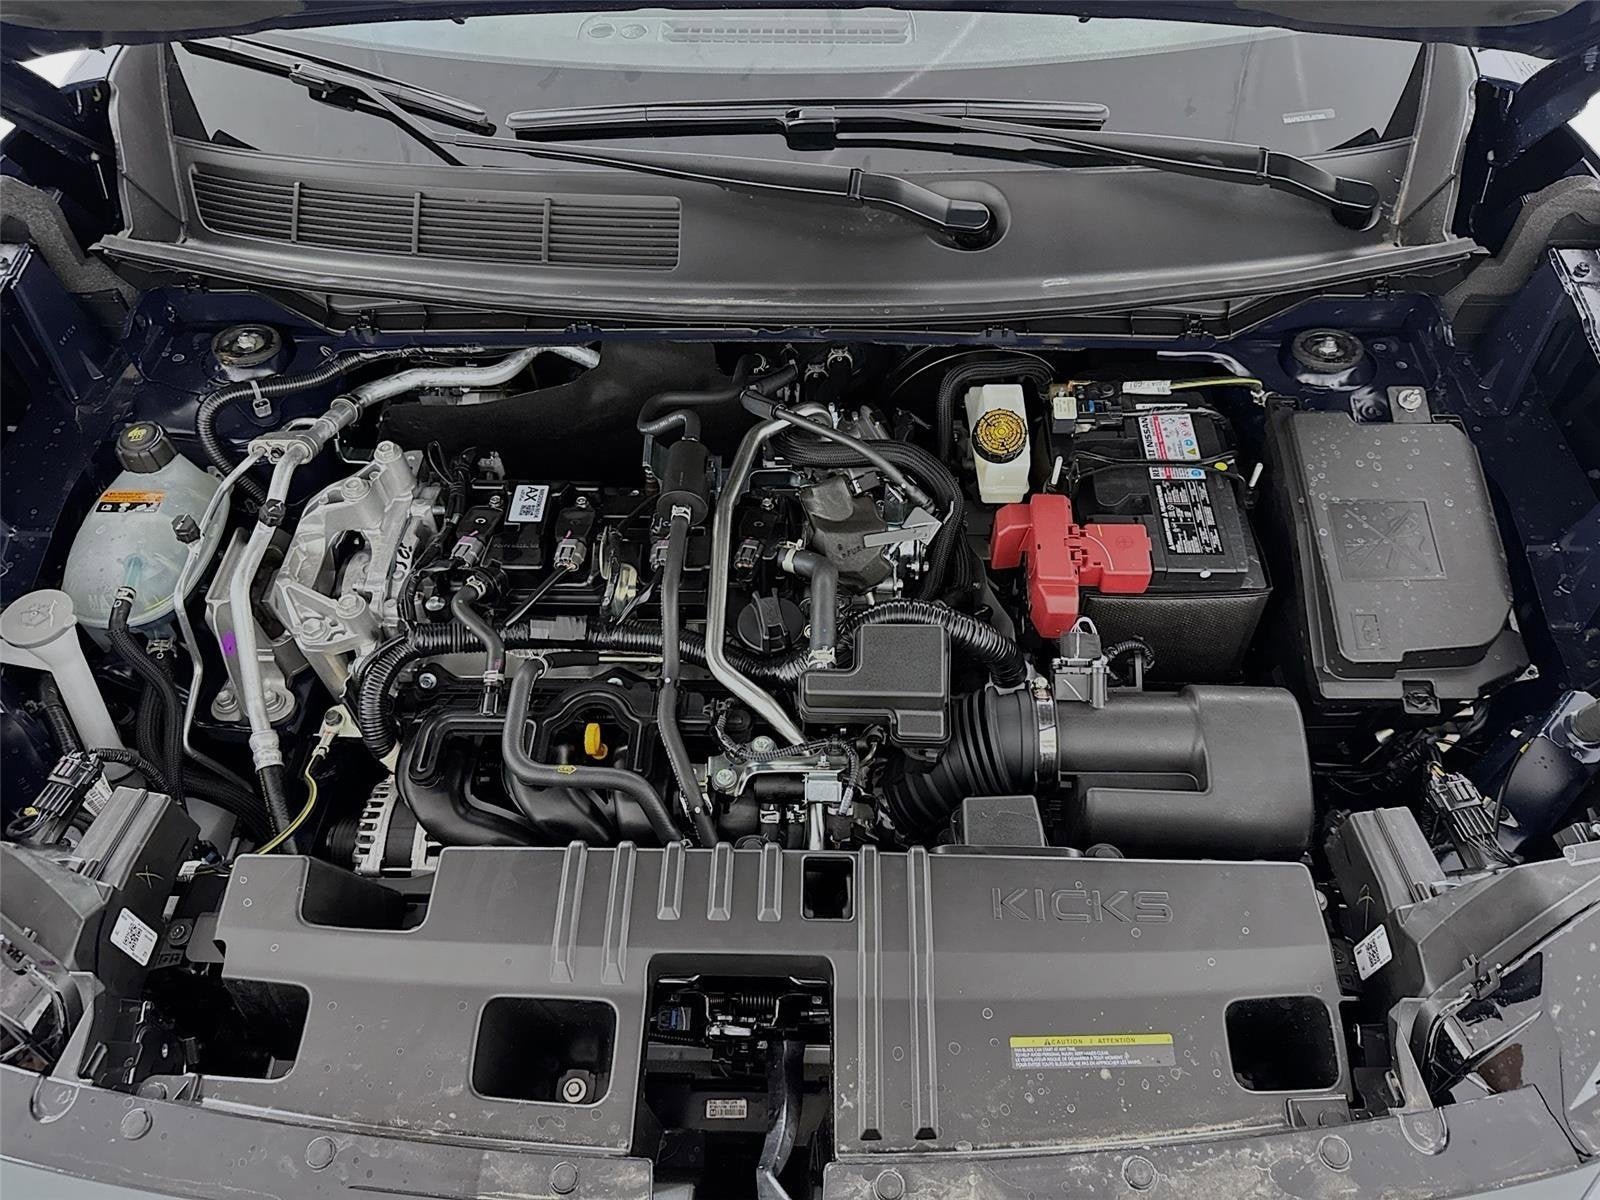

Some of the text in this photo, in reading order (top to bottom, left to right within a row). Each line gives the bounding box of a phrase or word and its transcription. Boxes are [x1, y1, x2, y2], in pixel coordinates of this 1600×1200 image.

[1141, 417, 1154, 448] NISSAN
[523, 486, 539, 502] AX
[991, 887, 1174, 923] KICKS
